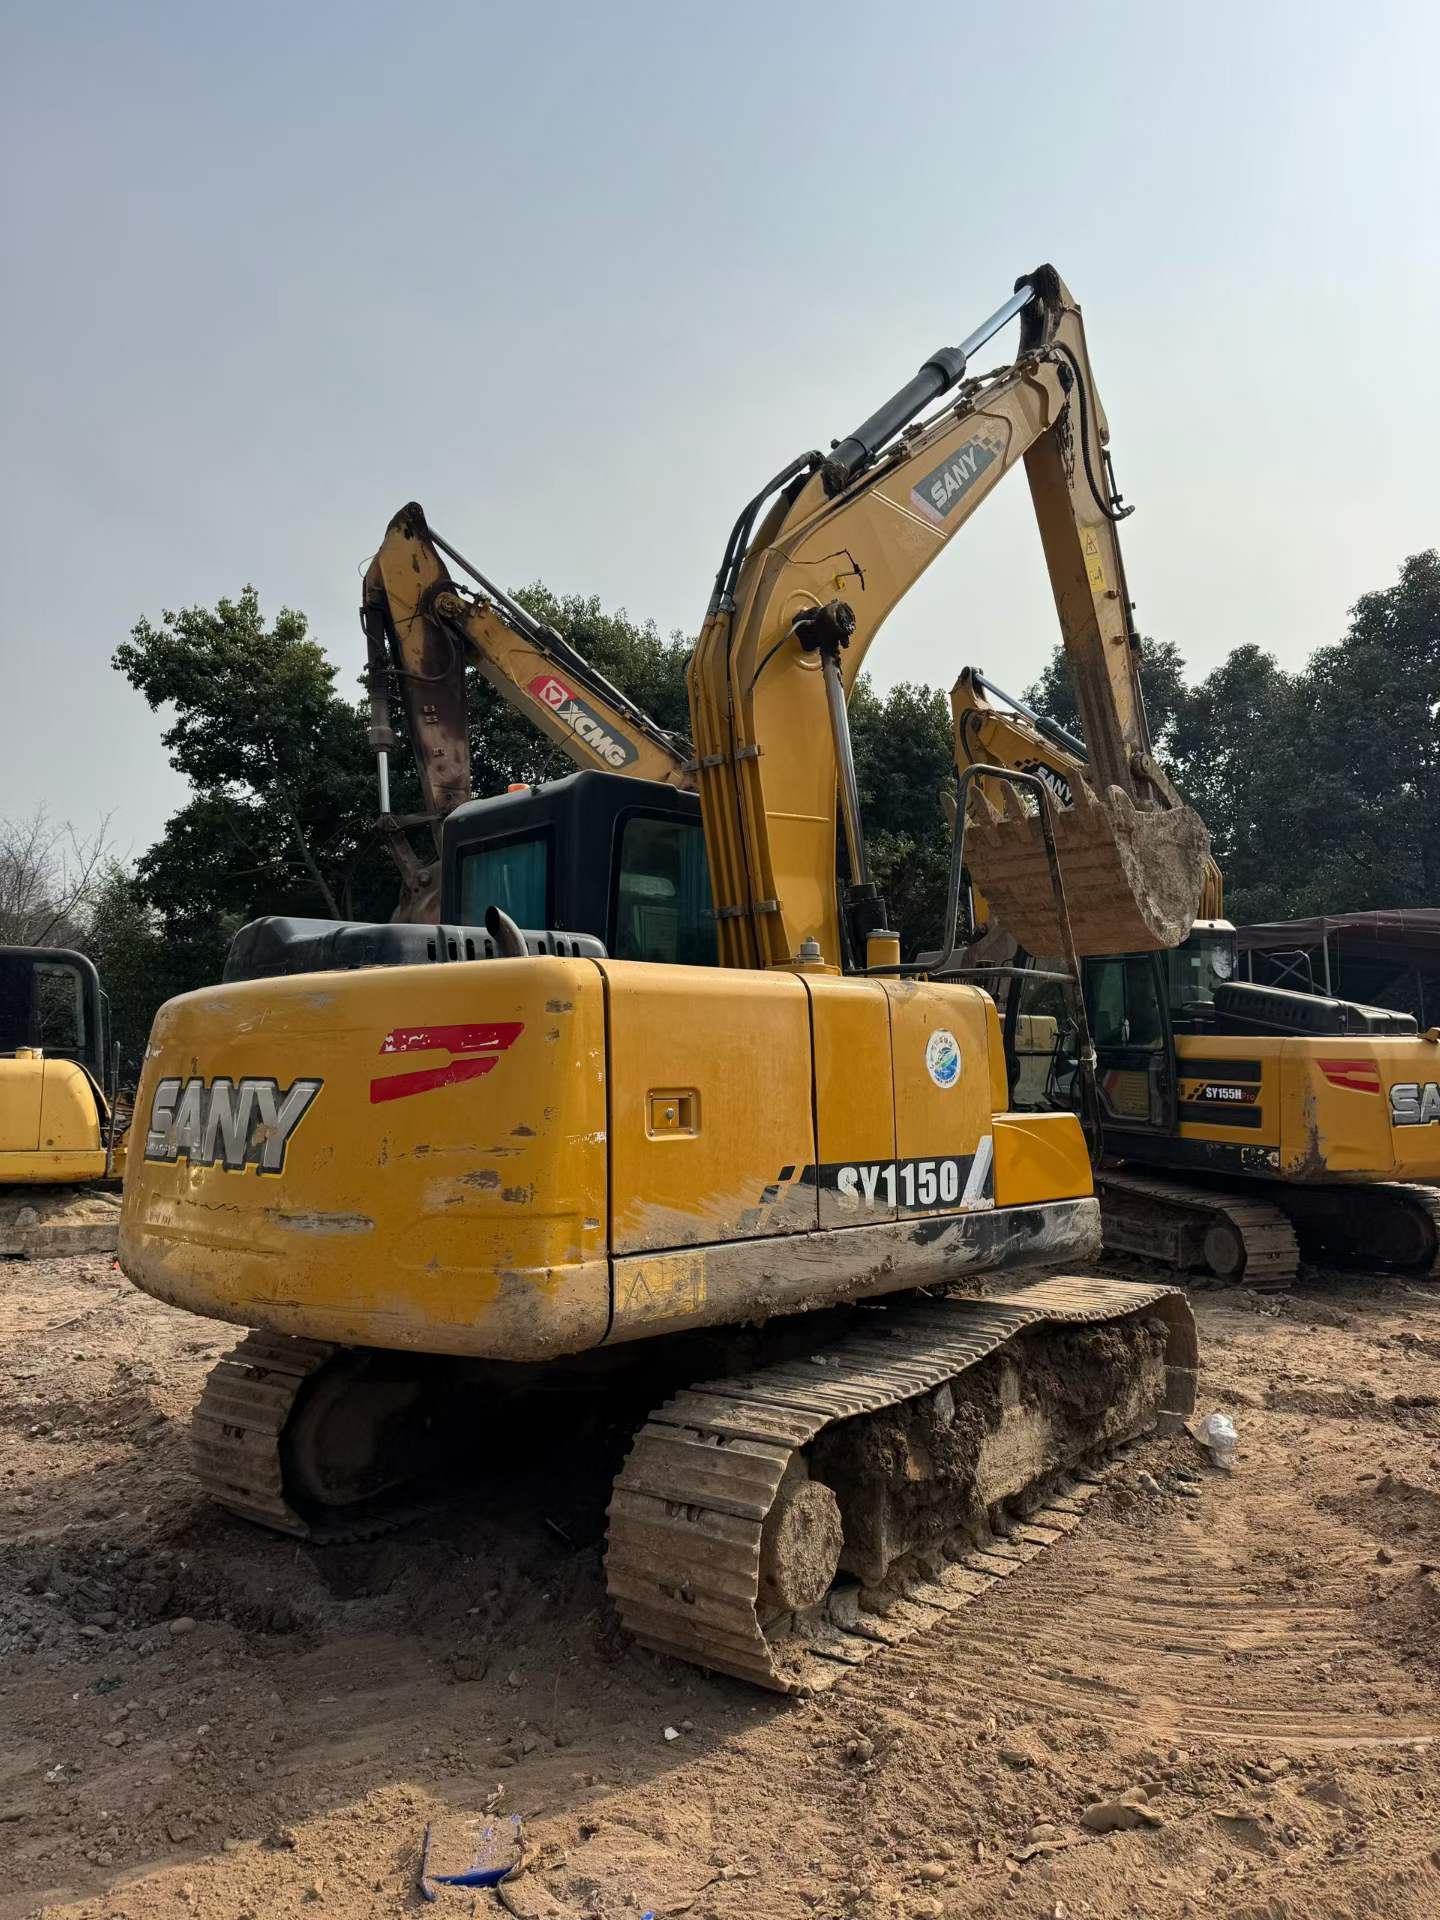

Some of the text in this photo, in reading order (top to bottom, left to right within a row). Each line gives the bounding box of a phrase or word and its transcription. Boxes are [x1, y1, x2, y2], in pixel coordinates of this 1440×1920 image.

[931, 447, 979, 508] SANY
[556, 700, 626, 767] XCMG
[1206, 1087, 1242, 1100] SY155H
[146, 1076, 324, 1177] SANY
